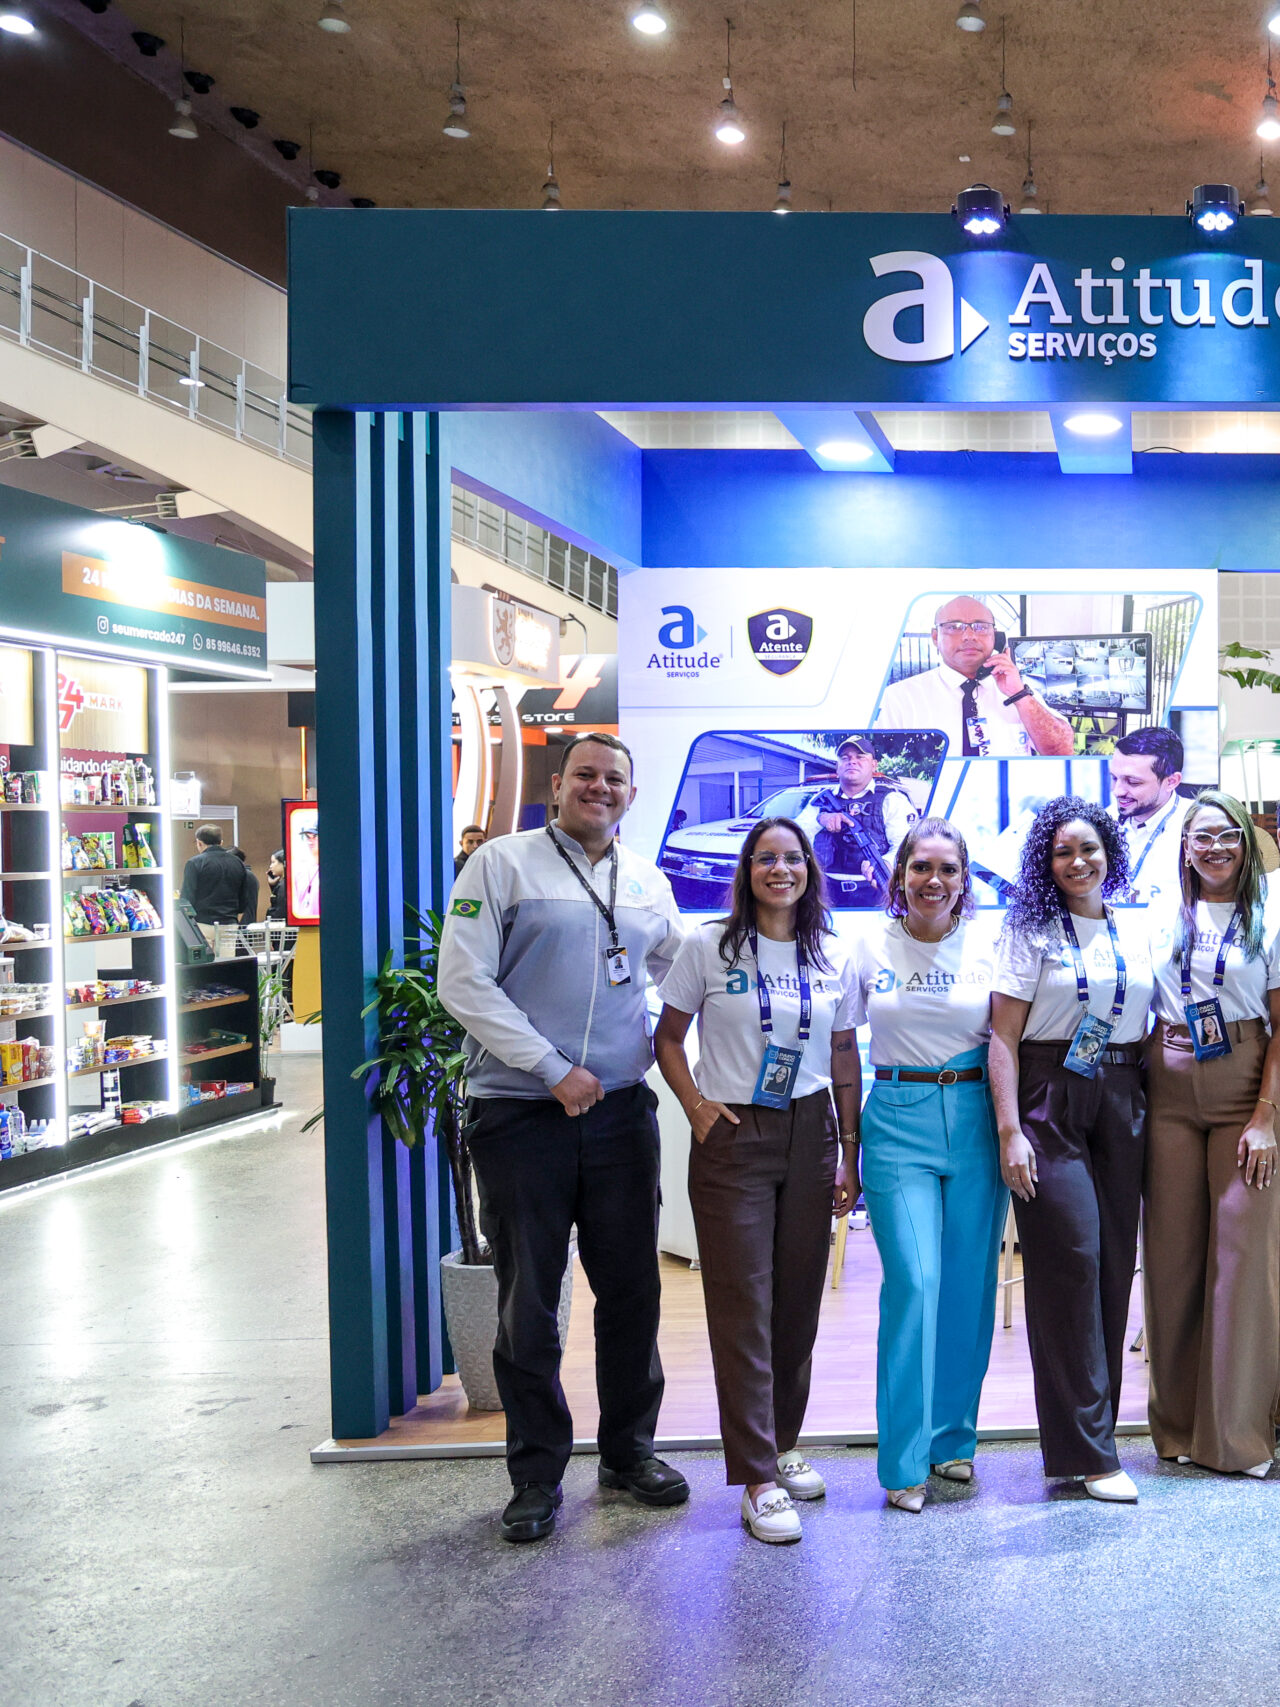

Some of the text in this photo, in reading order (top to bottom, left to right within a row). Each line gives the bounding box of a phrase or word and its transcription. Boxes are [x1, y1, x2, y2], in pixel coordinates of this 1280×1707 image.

[1008, 332, 1158, 365] SERVIÇOS
[82, 567, 101, 587] 24
[196, 593, 213, 611] DA
[213, 597, 261, 622] SEMANA.
[112, 623, 187, 647] seumercado247
[759, 641, 804, 653] Atente
[666, 670, 701, 680] SERVIÇOS
[1192, 943, 1215, 953] VIÇOS
[766, 989, 799, 998] ERVIÇOS
[905, 985, 949, 994] SERVIÇOS
